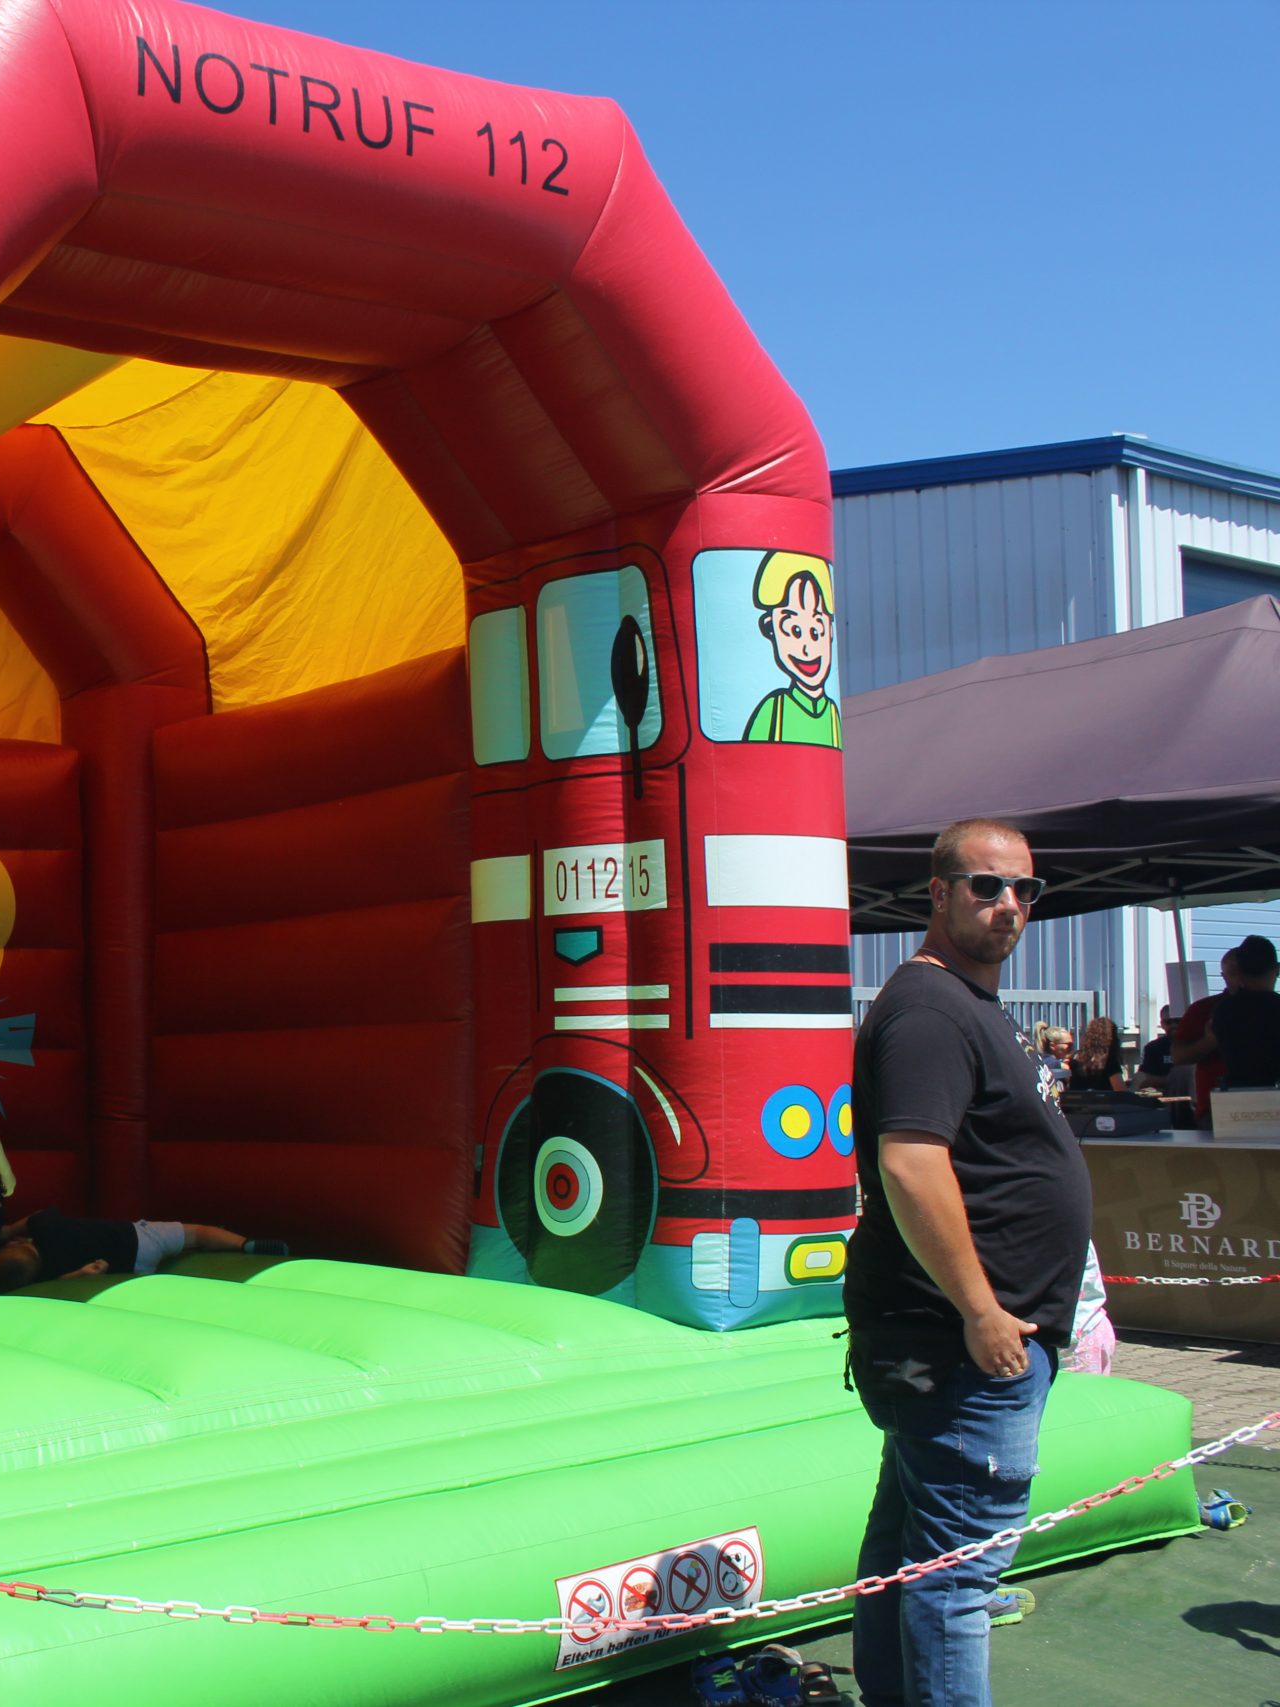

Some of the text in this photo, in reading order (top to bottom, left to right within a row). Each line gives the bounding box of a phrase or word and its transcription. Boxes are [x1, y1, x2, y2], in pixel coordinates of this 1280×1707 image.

[136, 36, 569, 196] NOTRUF 112
[562, 1647, 603, 1666] Eltern
[607, 1632, 649, 1653] haften
